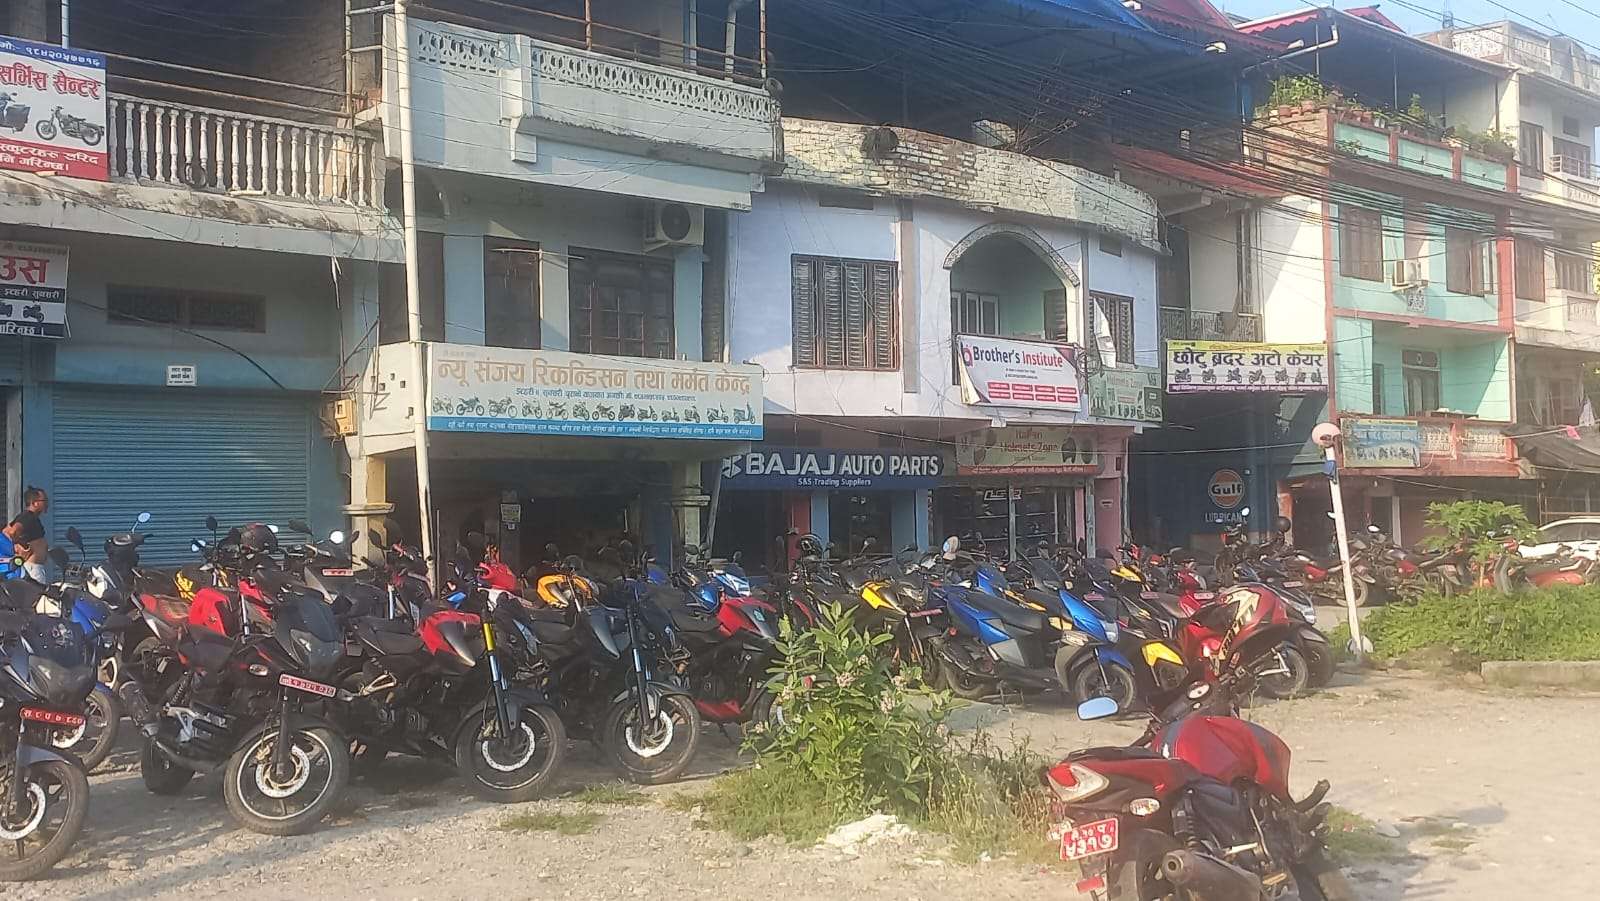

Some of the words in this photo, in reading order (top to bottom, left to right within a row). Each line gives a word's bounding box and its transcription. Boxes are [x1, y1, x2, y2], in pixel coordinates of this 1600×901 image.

[973, 345, 1020, 364] Brother's
[1022, 350, 1063, 367] Institute
[1251, 349, 1281, 366] अटो
[1286, 350, 1324, 366] केयर
[437, 359, 470, 387] न्यू
[474, 357, 526, 384] संजय
[633, 369, 666, 390] तथा
[746, 453, 835, 475] BAJAJ
[839, 455, 884, 475] AUTO
[889, 455, 939, 476] PARTS
[814, 477, 840, 488] Trading
[841, 477, 871, 488] Suppliers
[1211, 483, 1242, 495] Gulf
